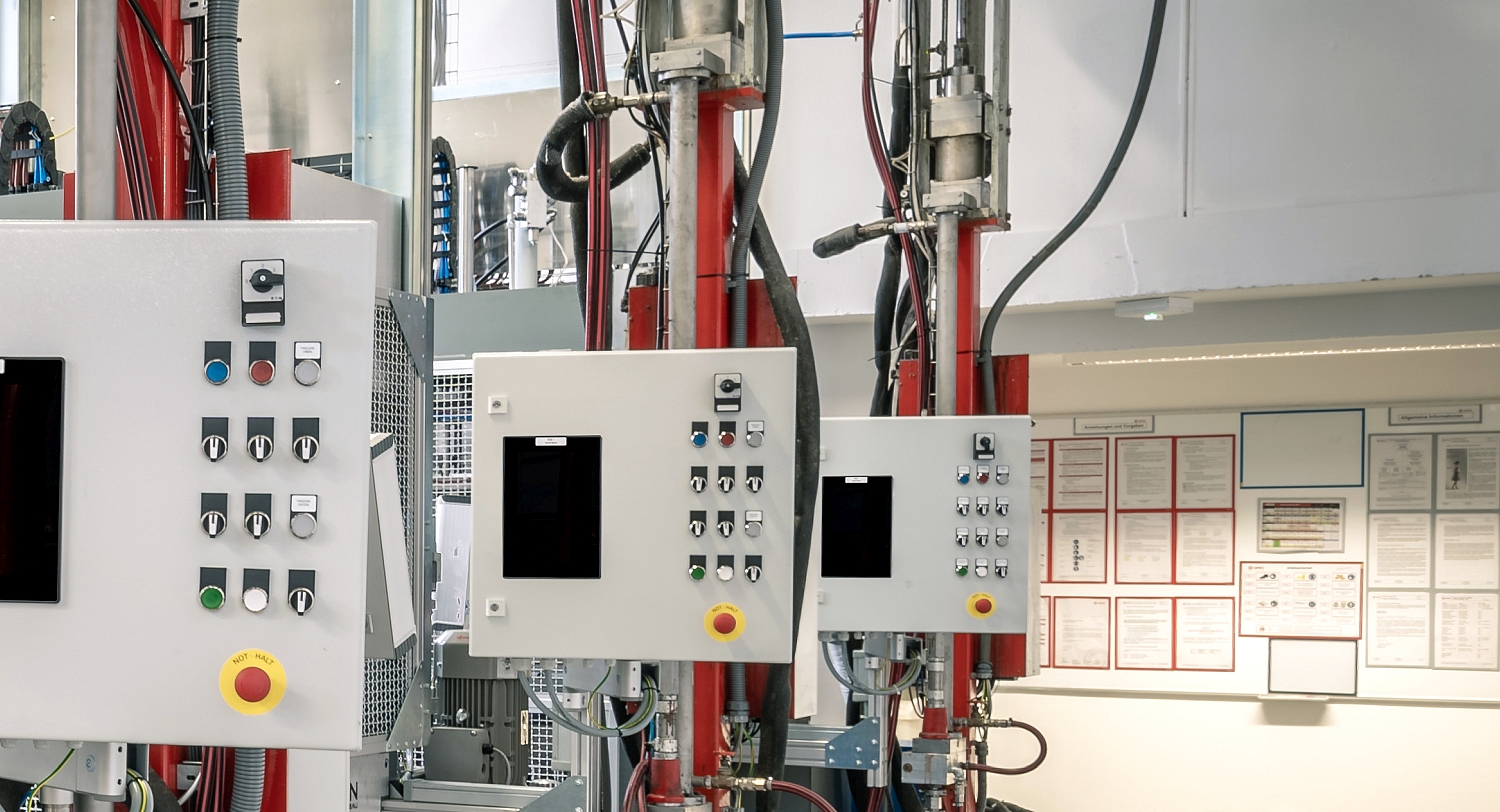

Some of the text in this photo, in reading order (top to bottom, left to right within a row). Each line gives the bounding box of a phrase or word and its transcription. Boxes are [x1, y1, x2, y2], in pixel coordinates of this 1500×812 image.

[725, 605, 739, 613] HALT
[232, 653, 248, 665] NOT
[255, 653, 275, 665] HALT
